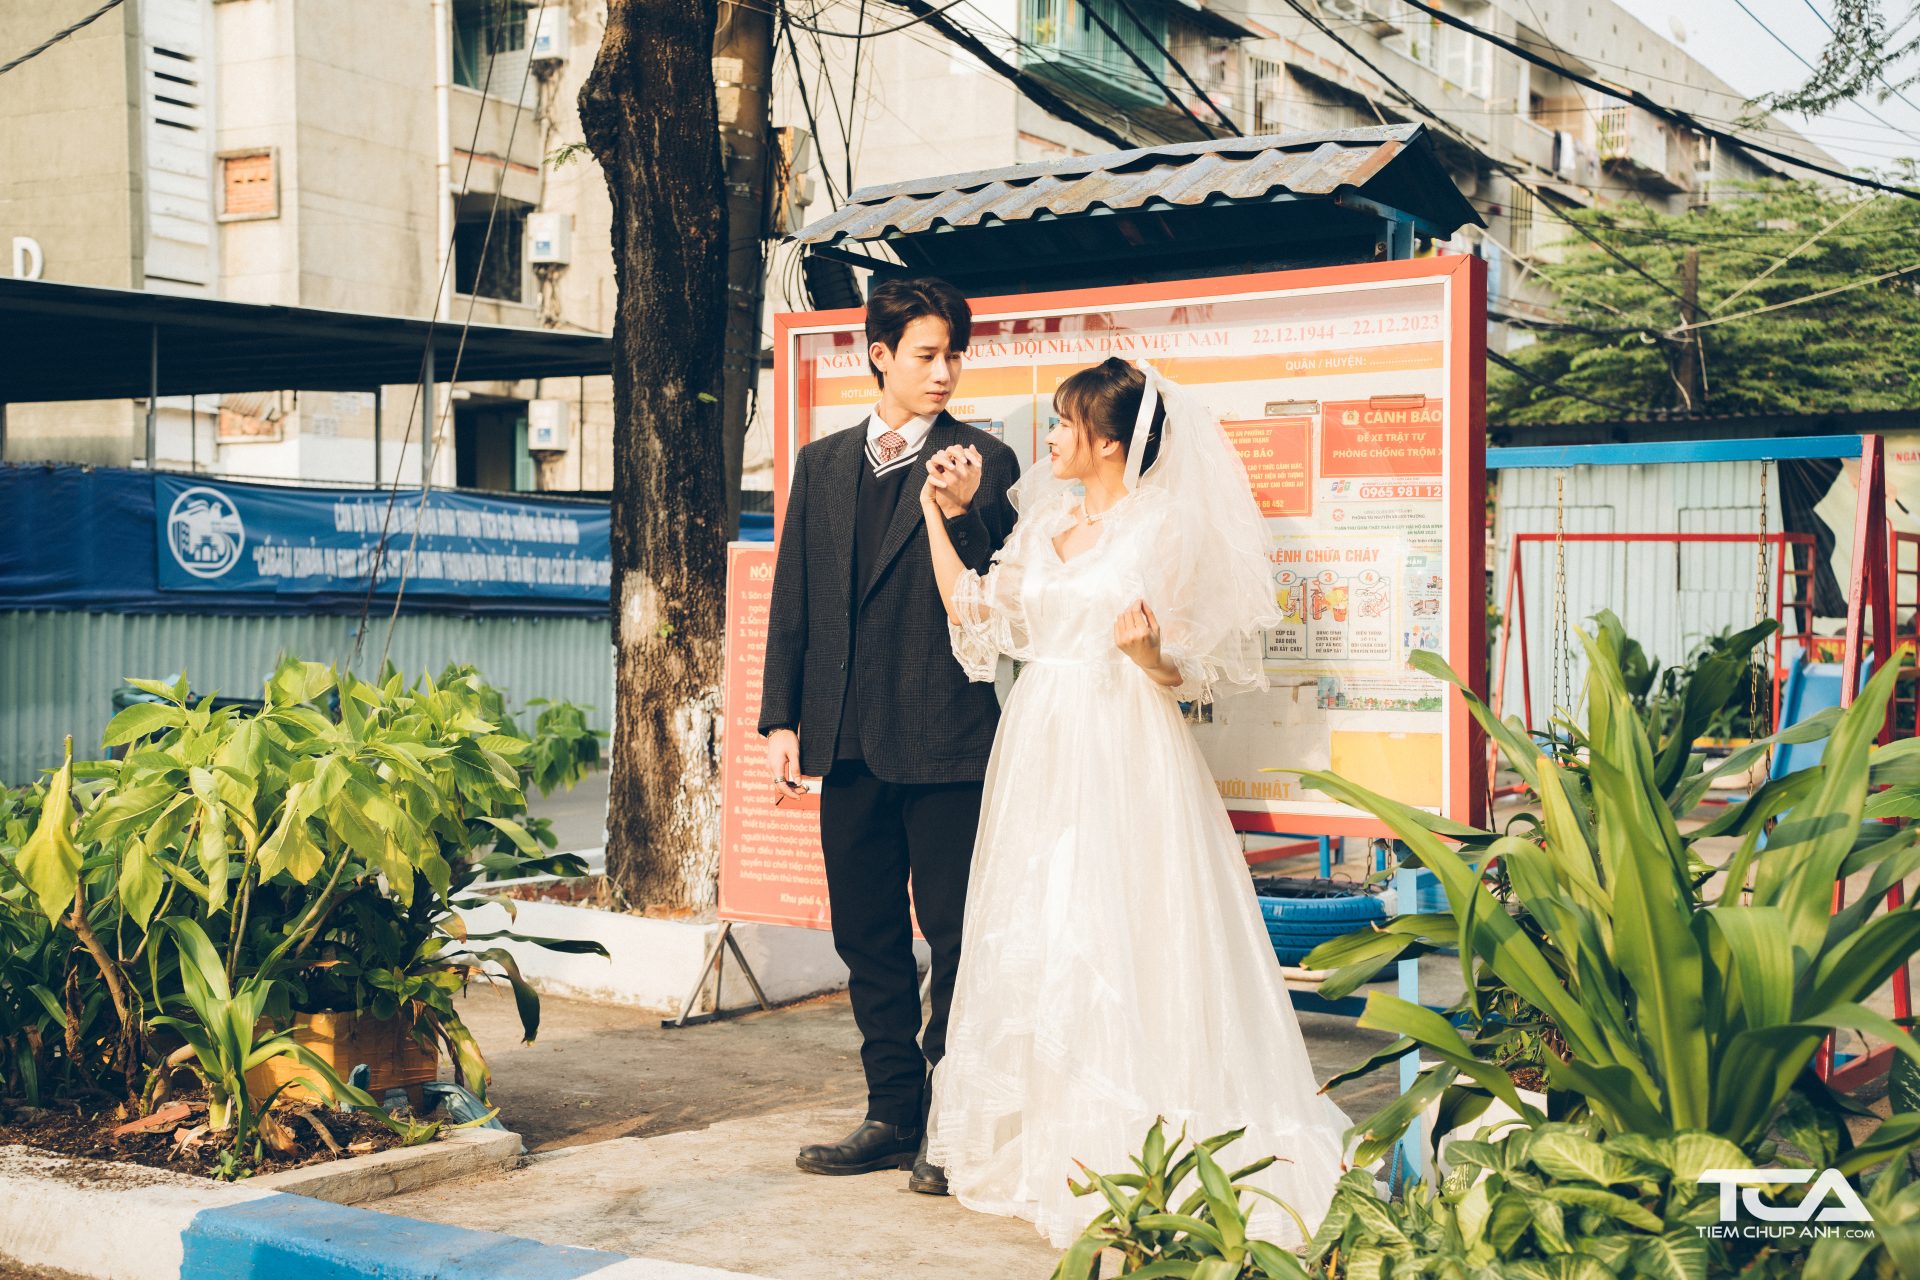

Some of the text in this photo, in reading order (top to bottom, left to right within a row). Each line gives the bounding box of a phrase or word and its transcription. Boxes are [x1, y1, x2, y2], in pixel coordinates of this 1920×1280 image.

[820, 351, 864, 370] NGÀY
[1047, 335, 1096, 354] NHÂN
[1100, 333, 1136, 352] DÂN
[1140, 332, 1184, 352] VIỆT
[1186, 331, 1229, 347] NAM
[1251, 326, 1336, 345] 22.12.1944
[1352, 315, 1441, 336] 22.12.2023
[1364, 407, 1442, 425] CẢNH BÁO
[1253, 446, 1275, 460] BÁO
[1333, 447, 1367, 459] PHÒNG
[1370, 445, 1405, 458] CHỐNG
[1408, 446, 1436, 460] TRỘM
[1361, 486, 1394, 499] 0965
[1397, 485, 1421, 498] 981
[1305, 546, 1341, 563] CHỮA
[1345, 546, 1380, 563] CHÁY
[750, 562, 773, 582] NỘI
[1281, 572, 1291, 583] 2
[1323, 571, 1333, 583] 3
